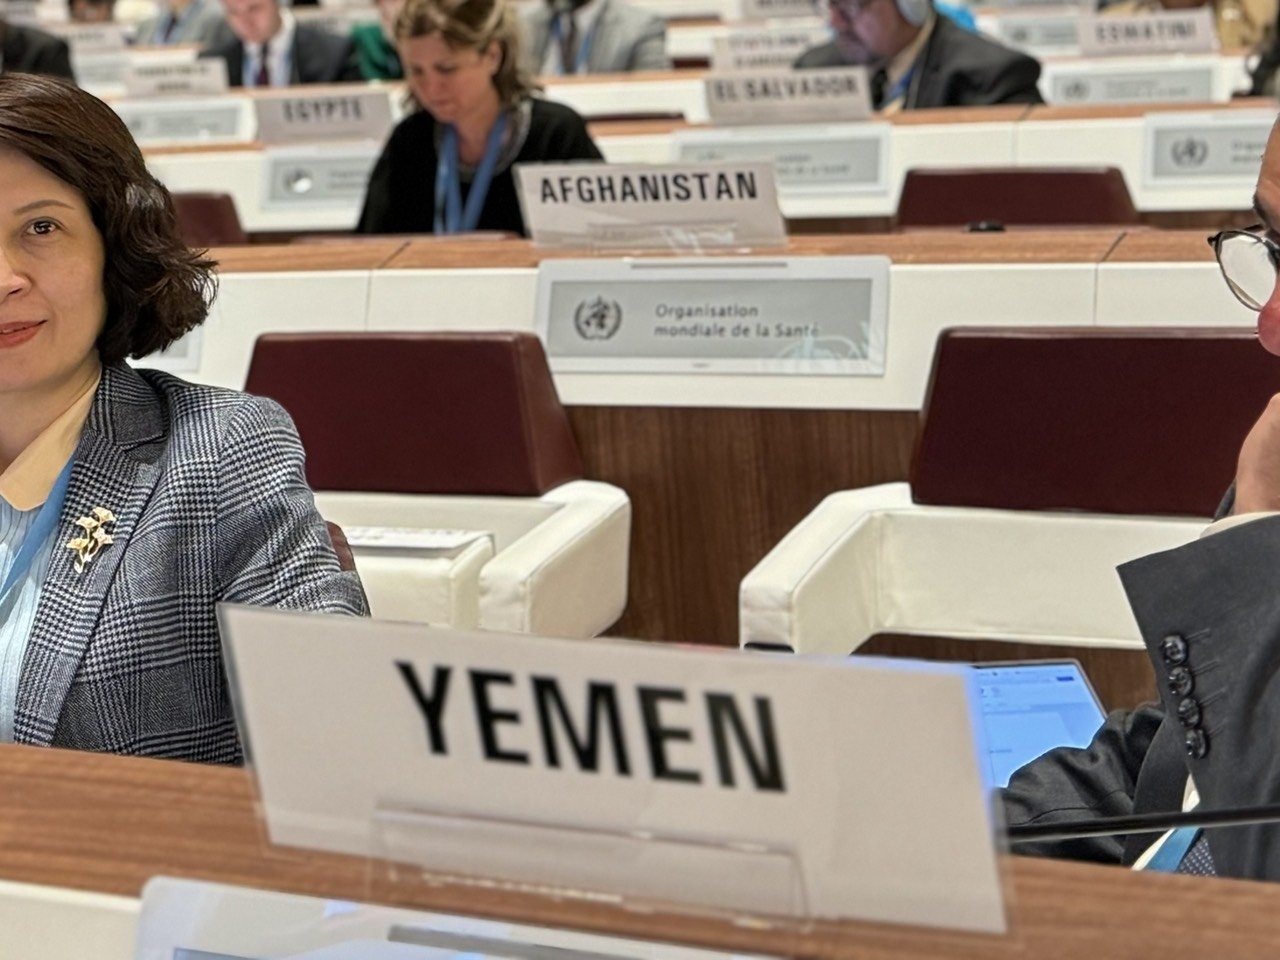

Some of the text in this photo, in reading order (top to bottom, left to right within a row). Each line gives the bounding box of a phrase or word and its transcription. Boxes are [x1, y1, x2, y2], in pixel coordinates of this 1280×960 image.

[715, 75, 858, 102] EL SALVADOR
[282, 98, 364, 123] EGYPTE
[540, 172, 758, 203] AFGHANISTAN
[655, 302, 759, 321] Organisation
[654, 320, 820, 338] mondiale de la Santé
[394, 660, 788, 793] YEMEN
